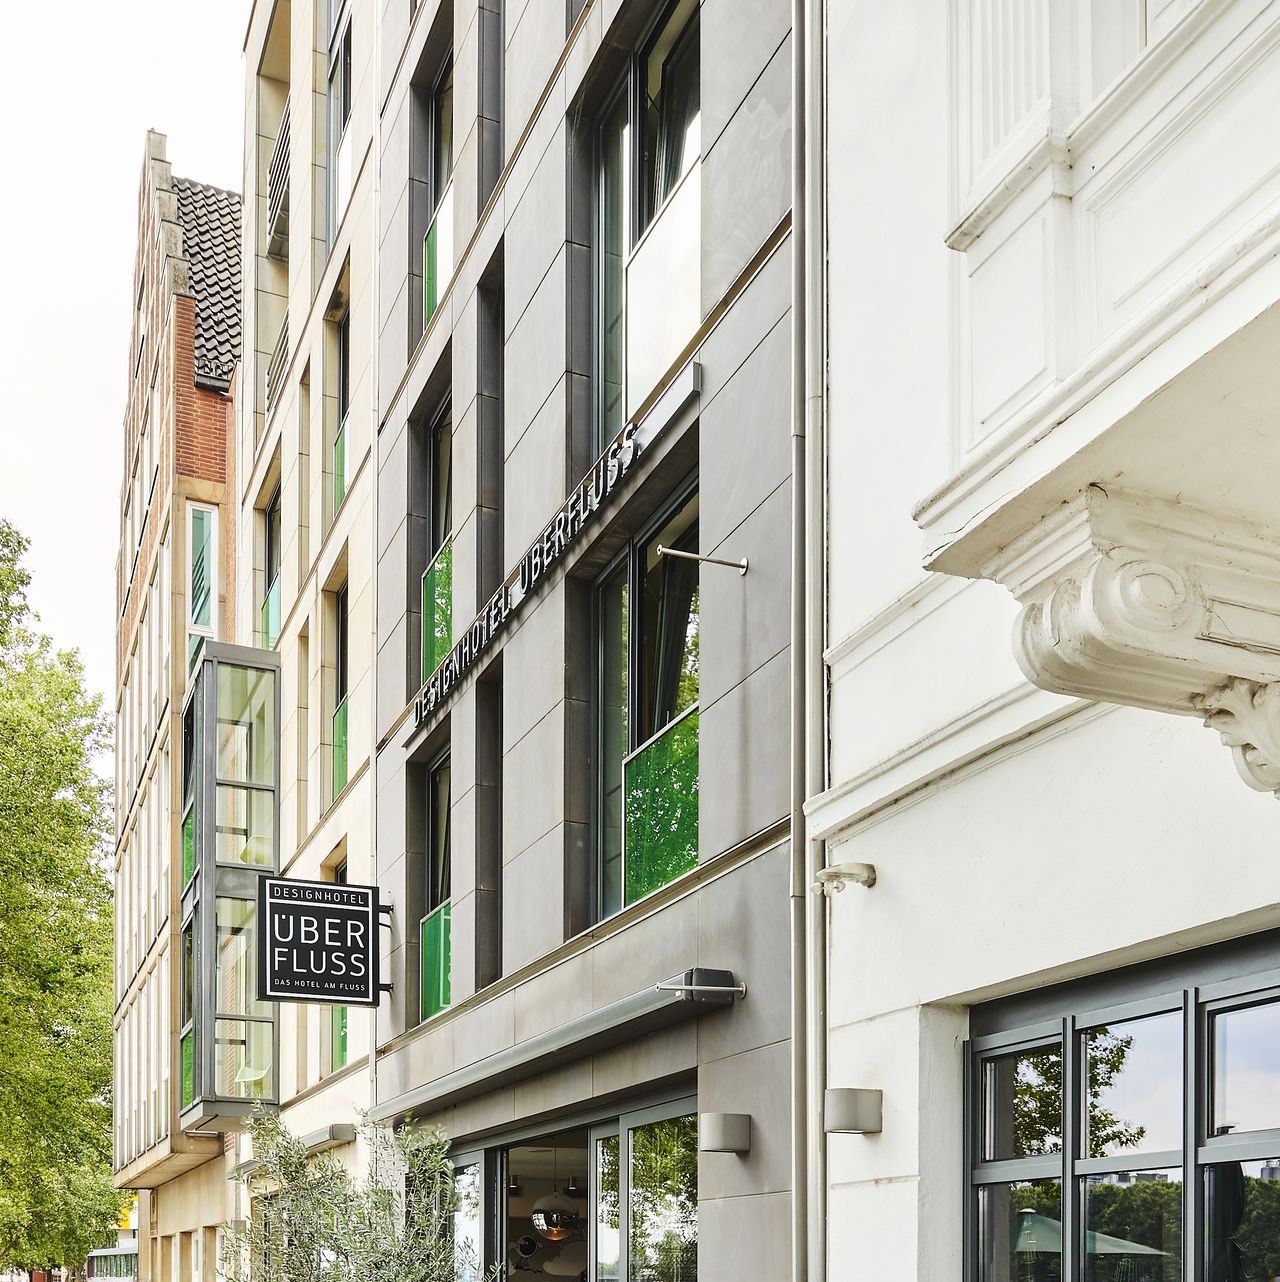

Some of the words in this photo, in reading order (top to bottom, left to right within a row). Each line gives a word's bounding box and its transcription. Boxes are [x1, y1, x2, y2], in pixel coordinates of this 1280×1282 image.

[413, 586, 514, 728] DESIGNHOTEL
[518, 422, 637, 595] ÜBERFLUSS
[274, 887, 365, 904] DESIGNHOTEL
[274, 913, 365, 949] ÜBER
[274, 947, 366, 977] FLUSS
[274, 978, 291, 986] DAS
[294, 980, 320, 988] HOTEL
[339, 983, 365, 991] FLUSS
